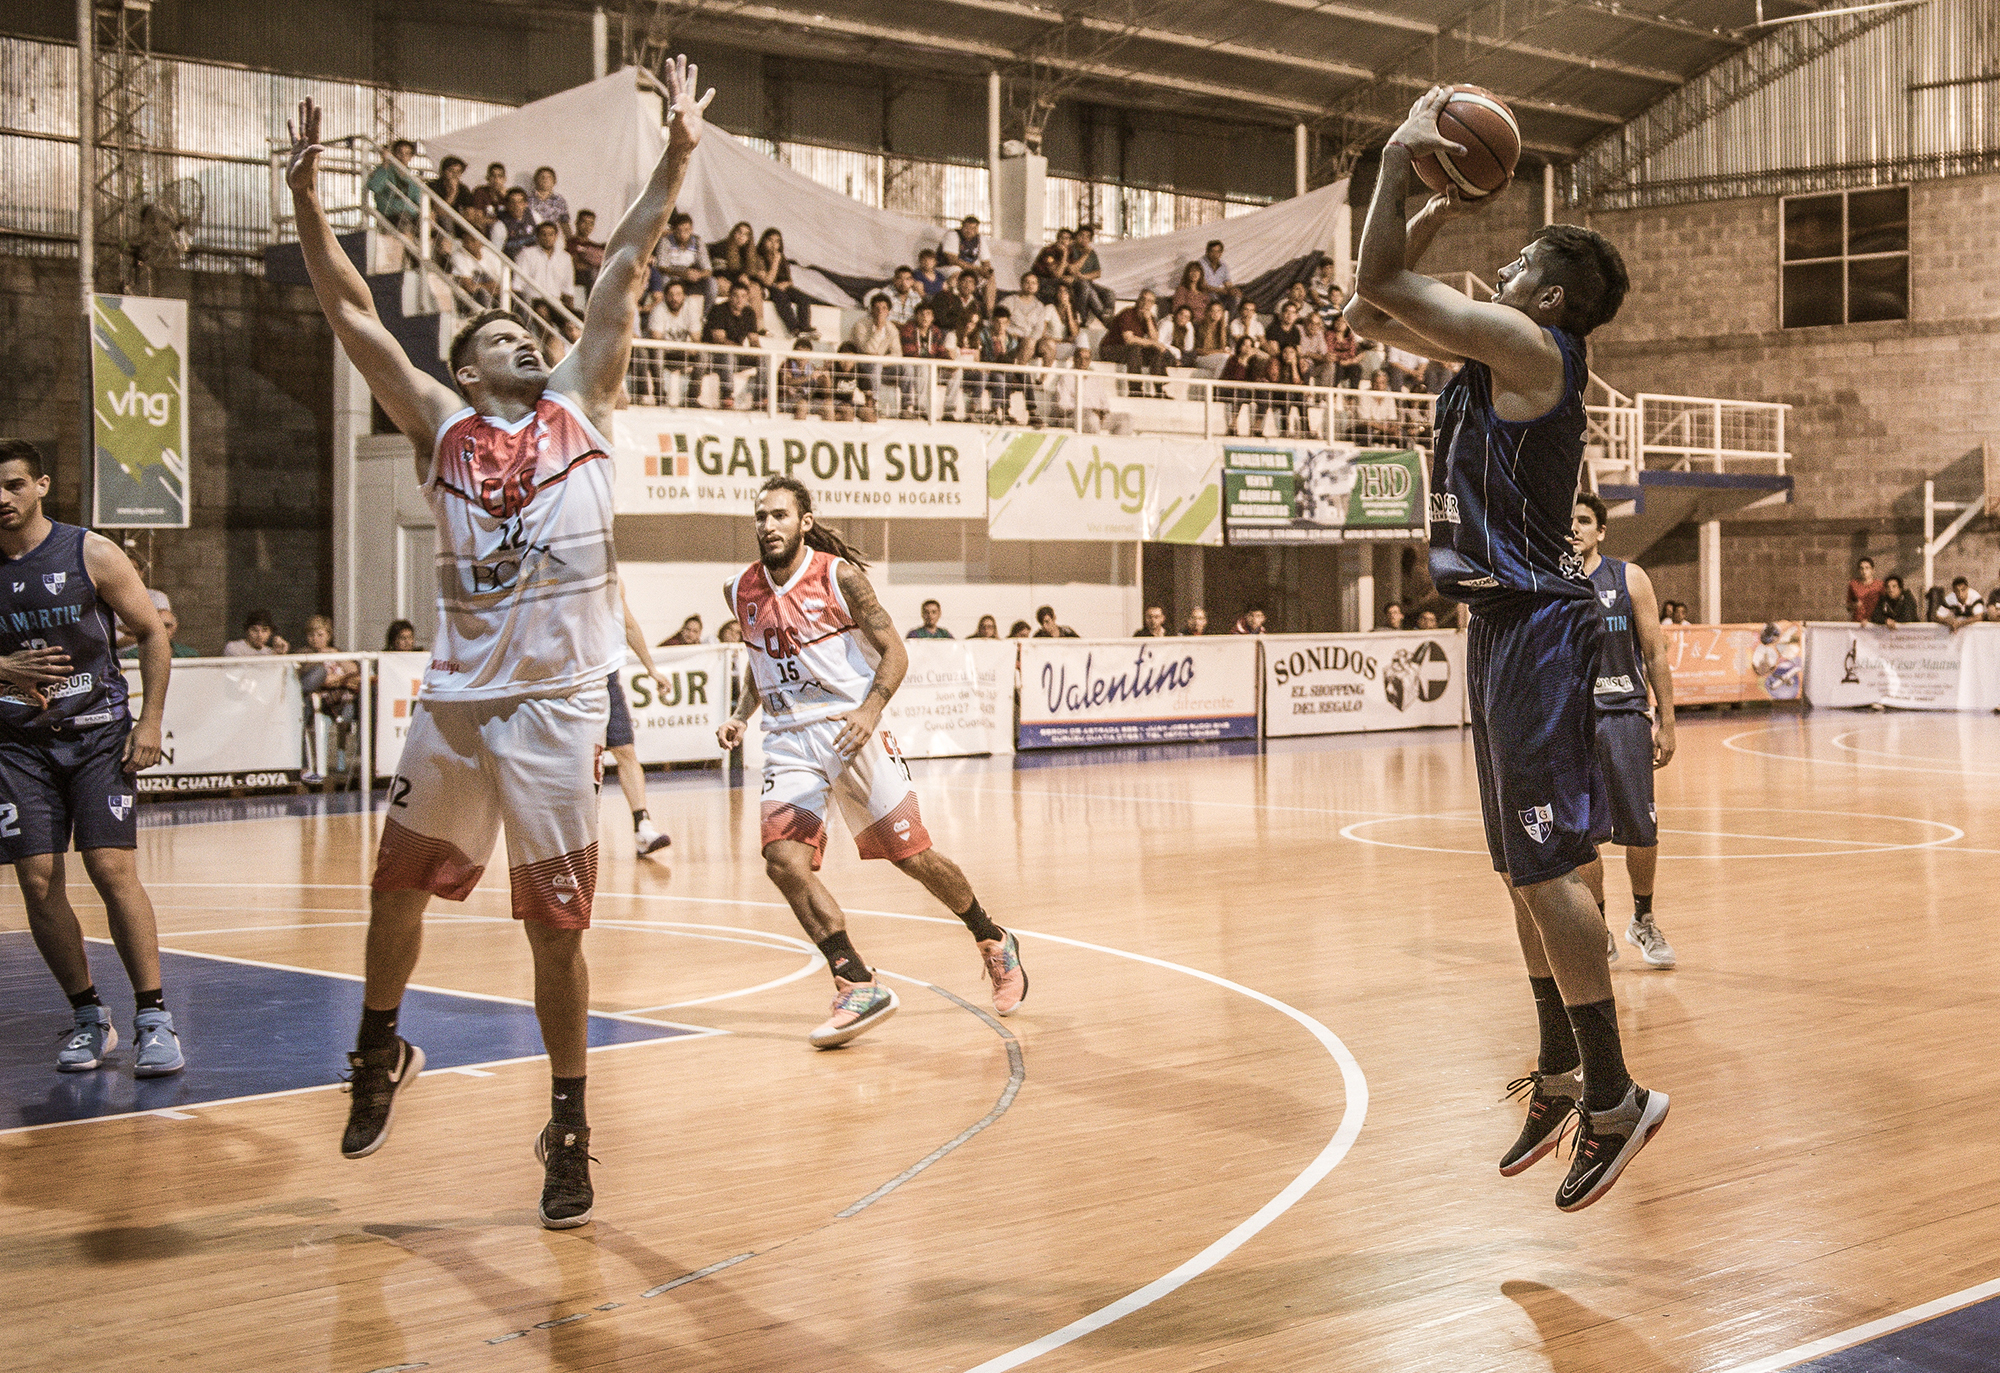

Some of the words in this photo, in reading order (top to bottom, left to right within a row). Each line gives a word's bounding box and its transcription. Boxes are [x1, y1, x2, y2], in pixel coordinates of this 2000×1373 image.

[107, 381, 169, 427] vhg
[695, 435, 870, 481] GALPON
[885, 442, 960, 483] SUR
[1066, 445, 1146, 514] vhg
[646, 485, 690, 500] TODA
[698, 486, 726, 501] UNA
[735, 487, 759, 501] VID
[898, 490, 962, 506] HOGARES
[10, 604, 82, 633] MARTIN
[776, 660, 800, 684] 15
[1042, 644, 1194, 713] Valentino
[1274, 646, 1378, 686] SONIDOS
[631, 671, 709, 710] SUR
[1291, 685, 1307, 698] EL
[1310, 683, 1365, 697] SHOPPING
[647, 714, 710, 729] HOGARES
[1292, 702, 1317, 715] DEL
[1319, 700, 1363, 714] REGALO
[245, 772, 289, 787] GOYA
